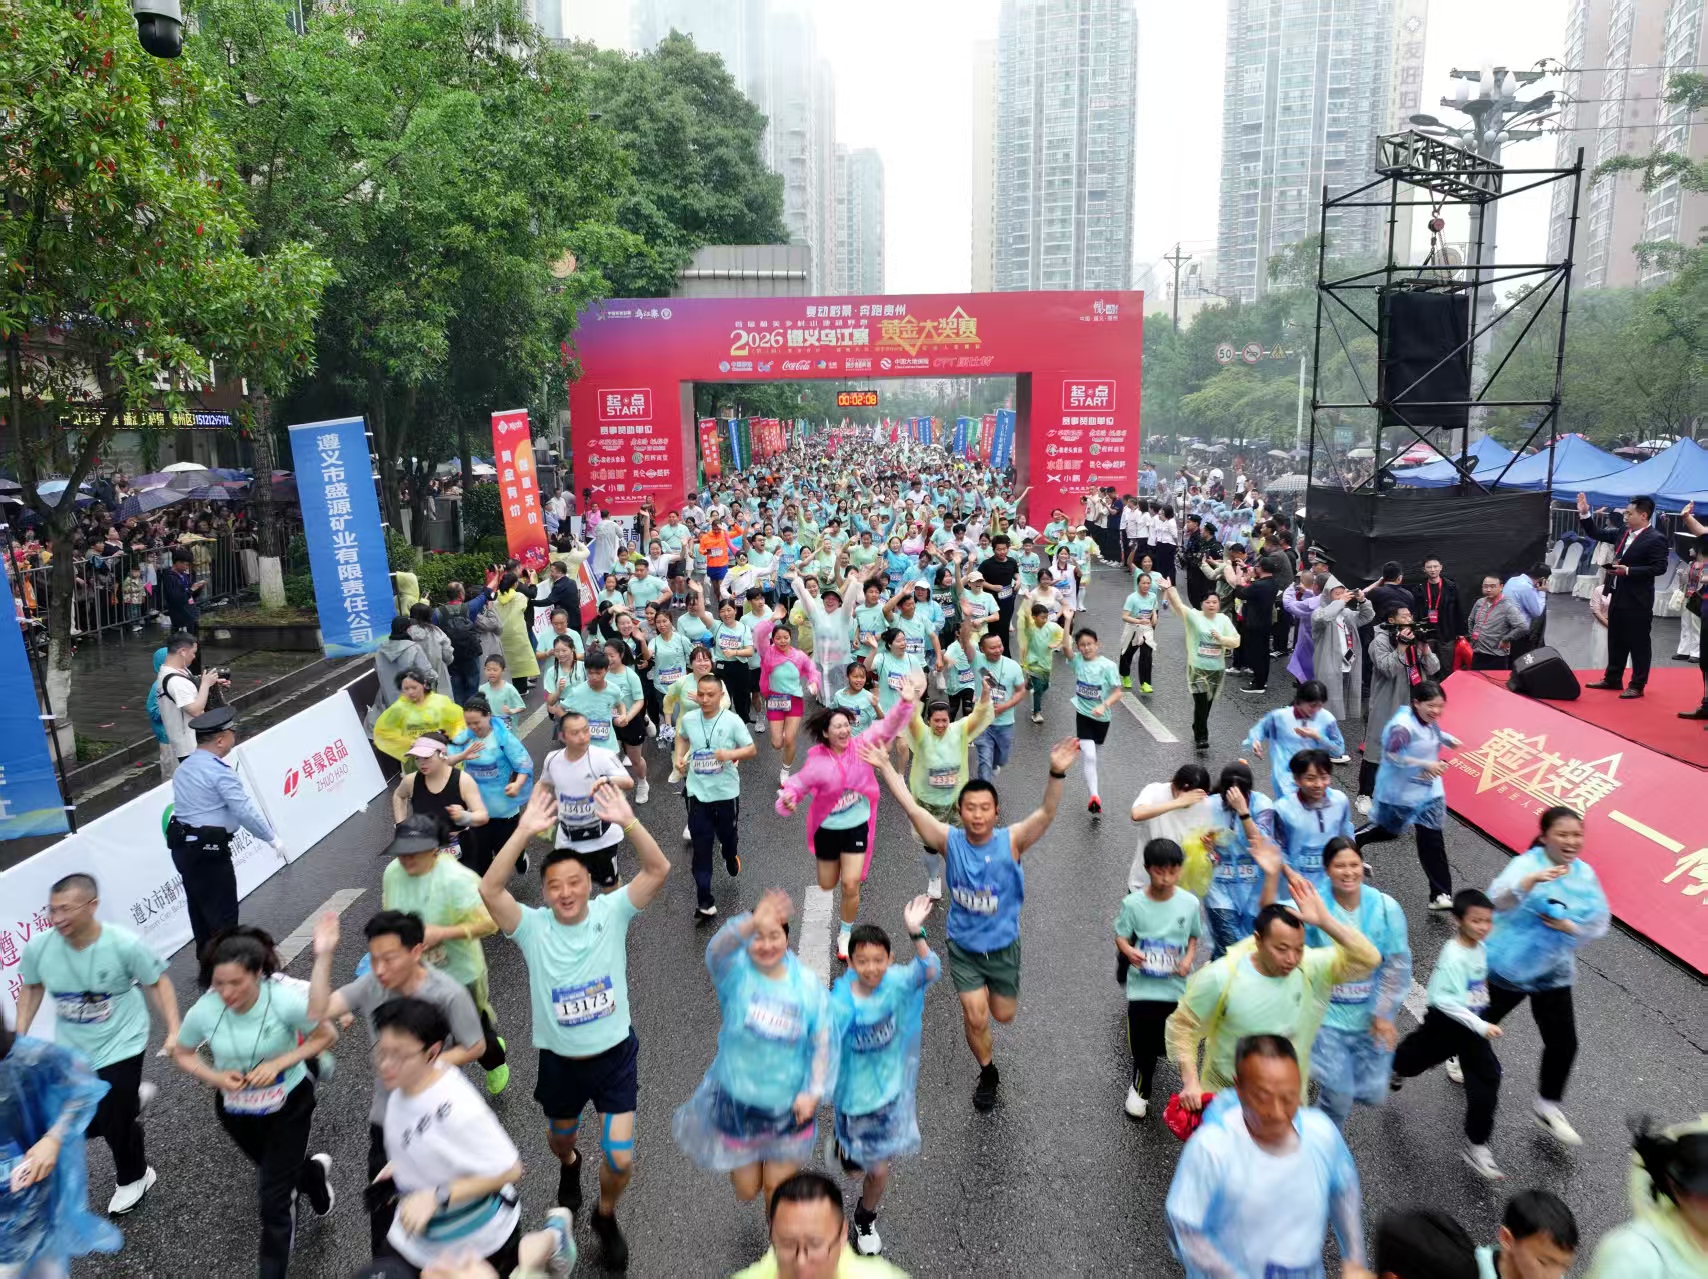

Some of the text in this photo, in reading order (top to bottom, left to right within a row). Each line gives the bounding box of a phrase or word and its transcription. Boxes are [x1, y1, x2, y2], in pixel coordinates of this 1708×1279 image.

[876, 311, 981, 344] 黄金大奖赛
[730, 329, 784, 356] 2026
[1220, 349, 1232, 358] 50
[606, 406, 645, 416] START
[838, 394, 877, 406] 00:02:08
[1070, 396, 1109, 407] START
[315, 432, 374, 644] 遵义市盛源矿业有限责任公司
[302, 738, 349, 780] 卓豪食品
[1476, 727, 1624, 816] 黄金大奖赛
[316, 763, 349, 792] ZHUO HAO
[563, 802, 592, 816] 13410
[130, 873, 184, 926] 遵义市播州
[562, 992, 608, 1017] 13173
